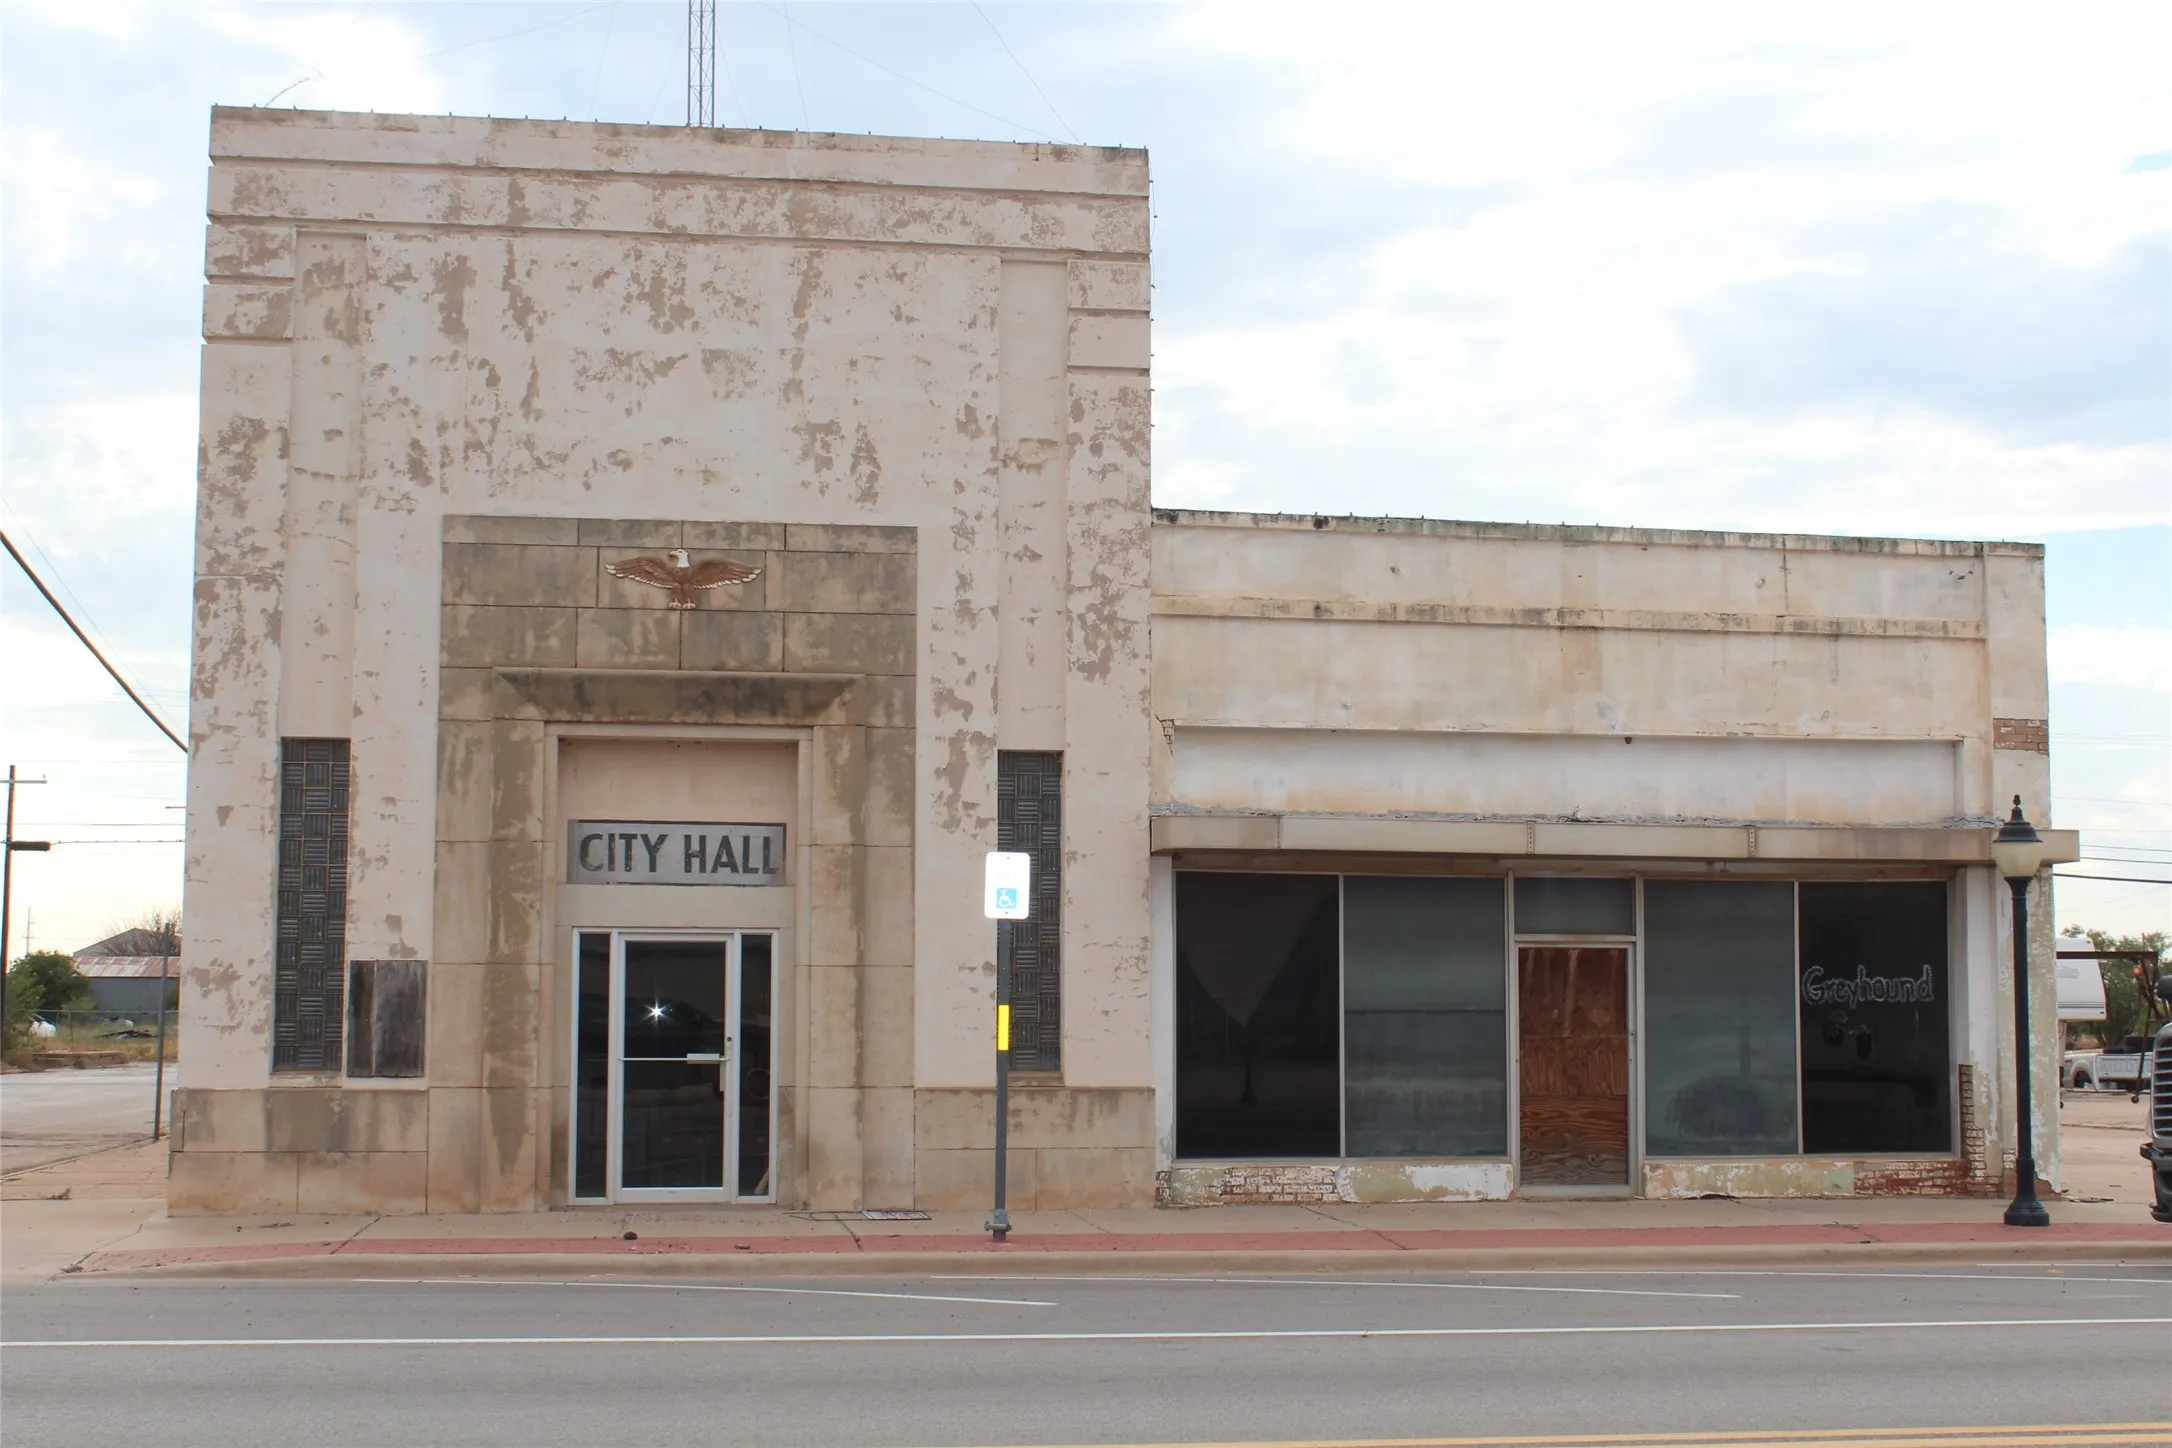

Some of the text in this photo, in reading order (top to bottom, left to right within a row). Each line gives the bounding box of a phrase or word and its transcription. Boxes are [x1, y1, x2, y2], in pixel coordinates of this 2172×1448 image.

[579, 832, 780, 875] CITY HALL
[1802, 964, 1934, 1009] Greyhound
